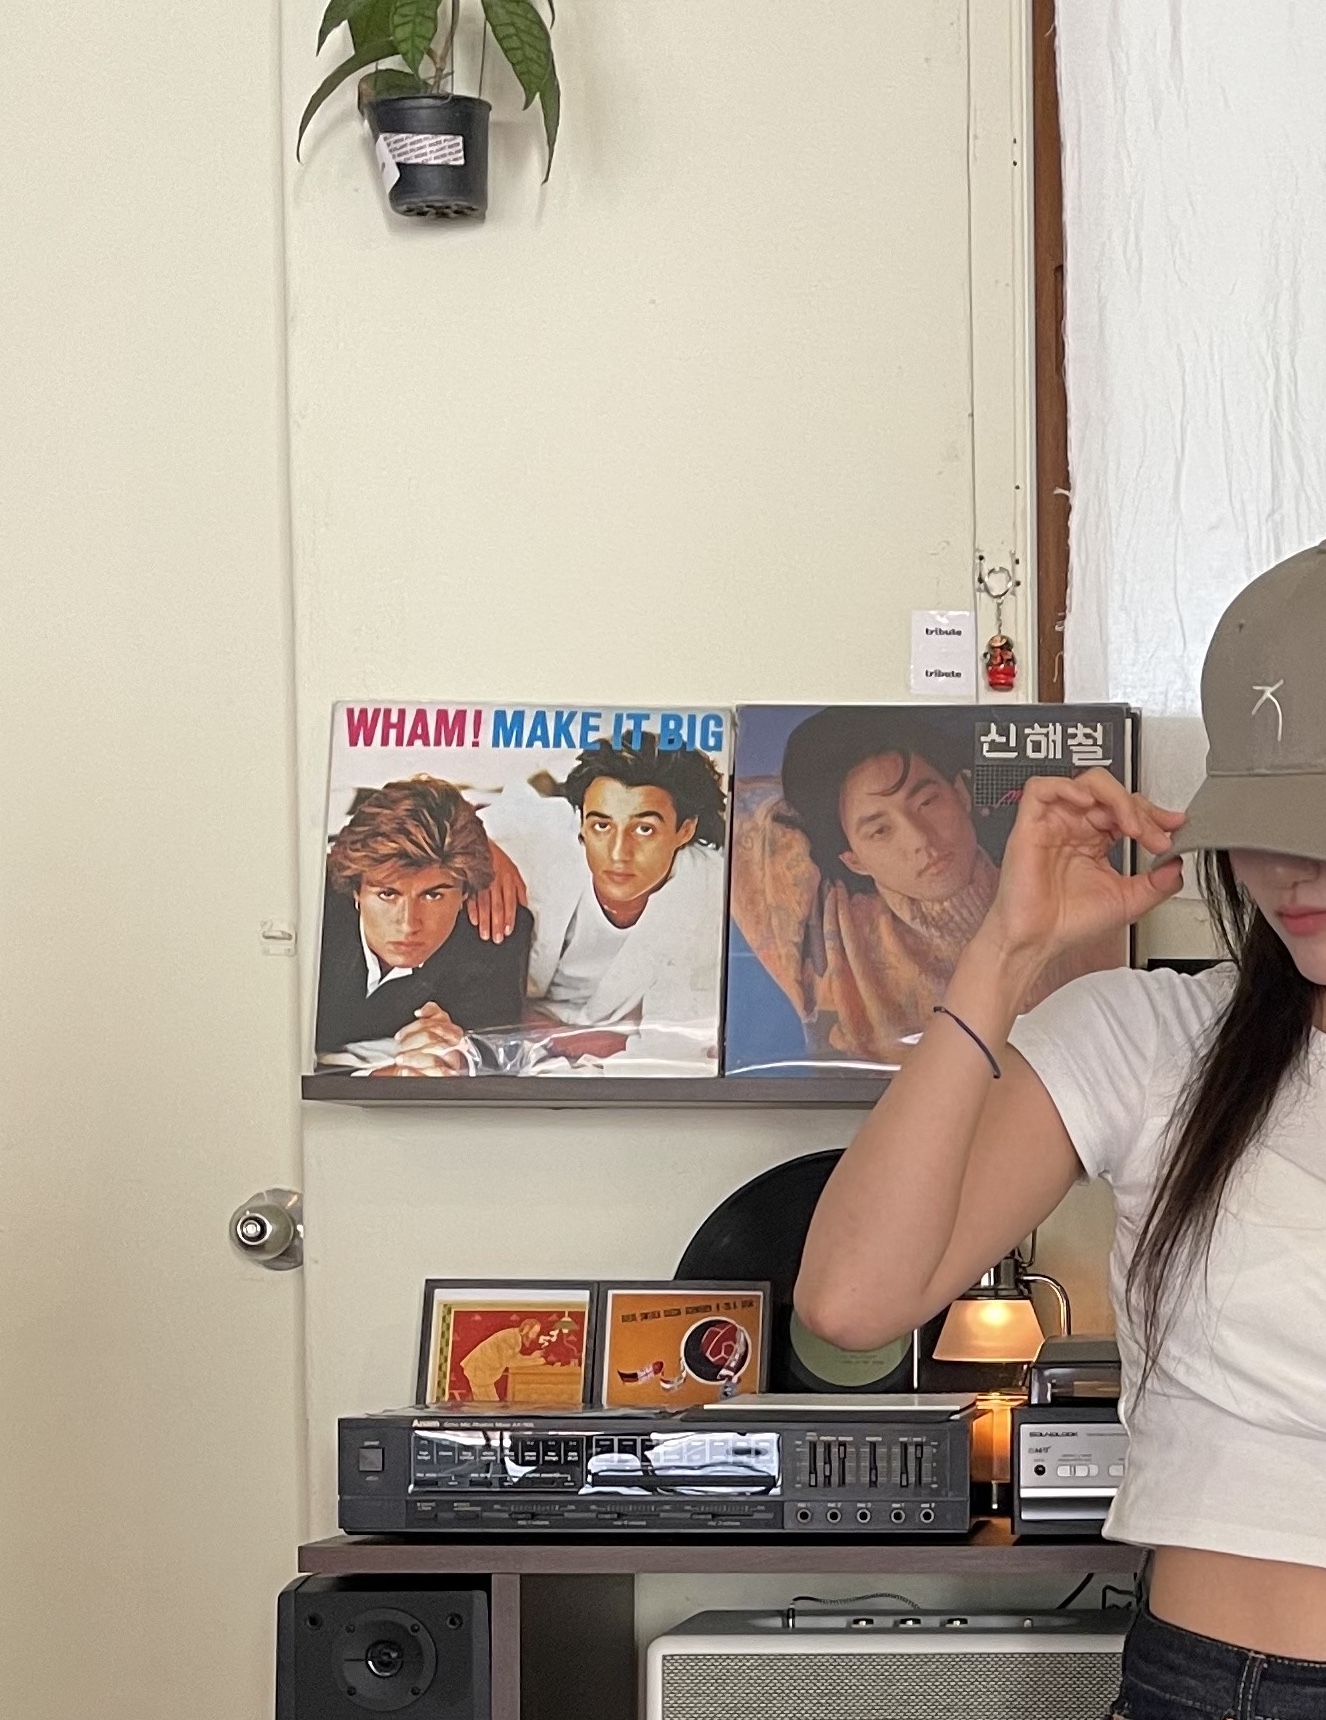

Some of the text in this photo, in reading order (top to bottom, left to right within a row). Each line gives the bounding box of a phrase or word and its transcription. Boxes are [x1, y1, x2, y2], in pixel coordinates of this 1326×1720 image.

[925, 628, 962, 636] tribute
[925, 669, 962, 678] tribute
[346, 707, 724, 752] WHAM! MAKE IT BIG
[980, 722, 1113, 766] 신해철
